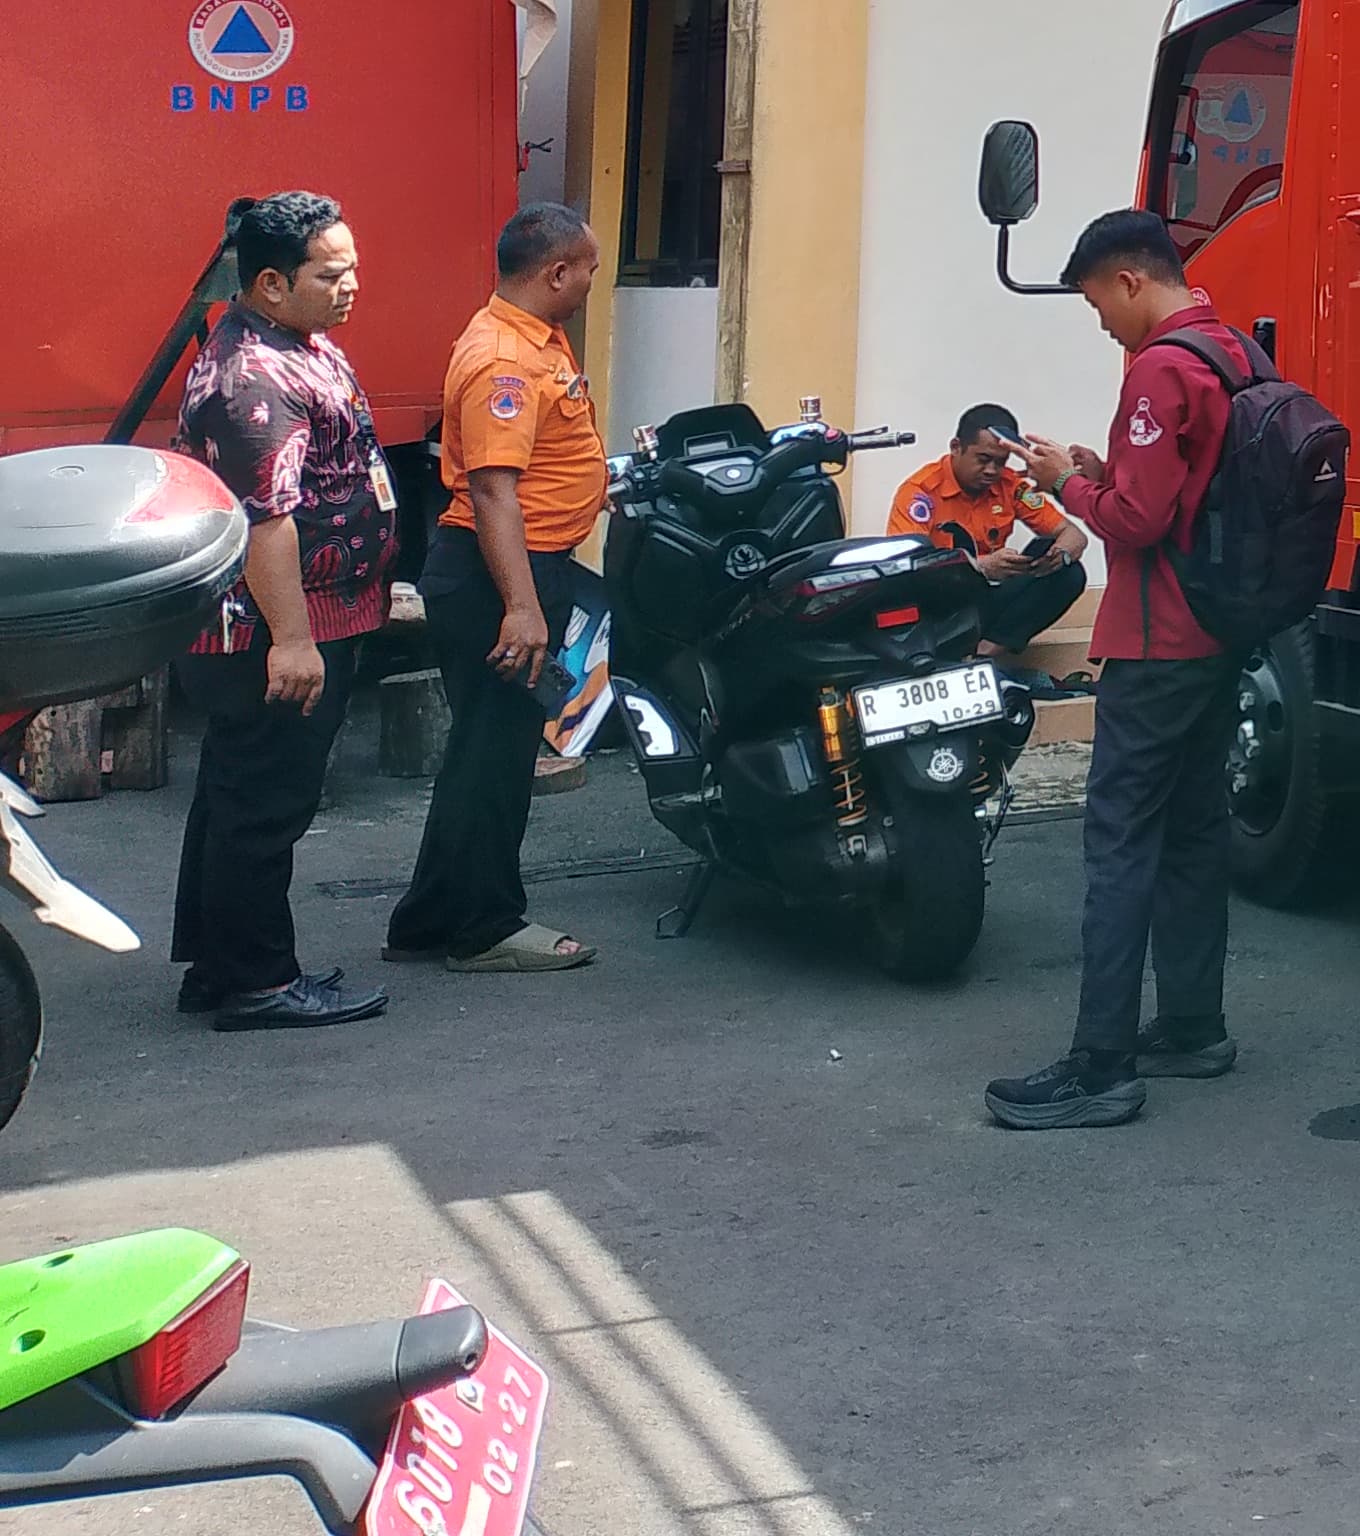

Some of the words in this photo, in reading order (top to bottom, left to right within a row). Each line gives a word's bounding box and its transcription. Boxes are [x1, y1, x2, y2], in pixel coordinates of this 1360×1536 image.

[171, 85, 309, 112] BNPB
[861, 694, 877, 717] R
[896, 679, 950, 708] 3808
[963, 670, 991, 694] EA
[941, 699, 997, 722] 10-29
